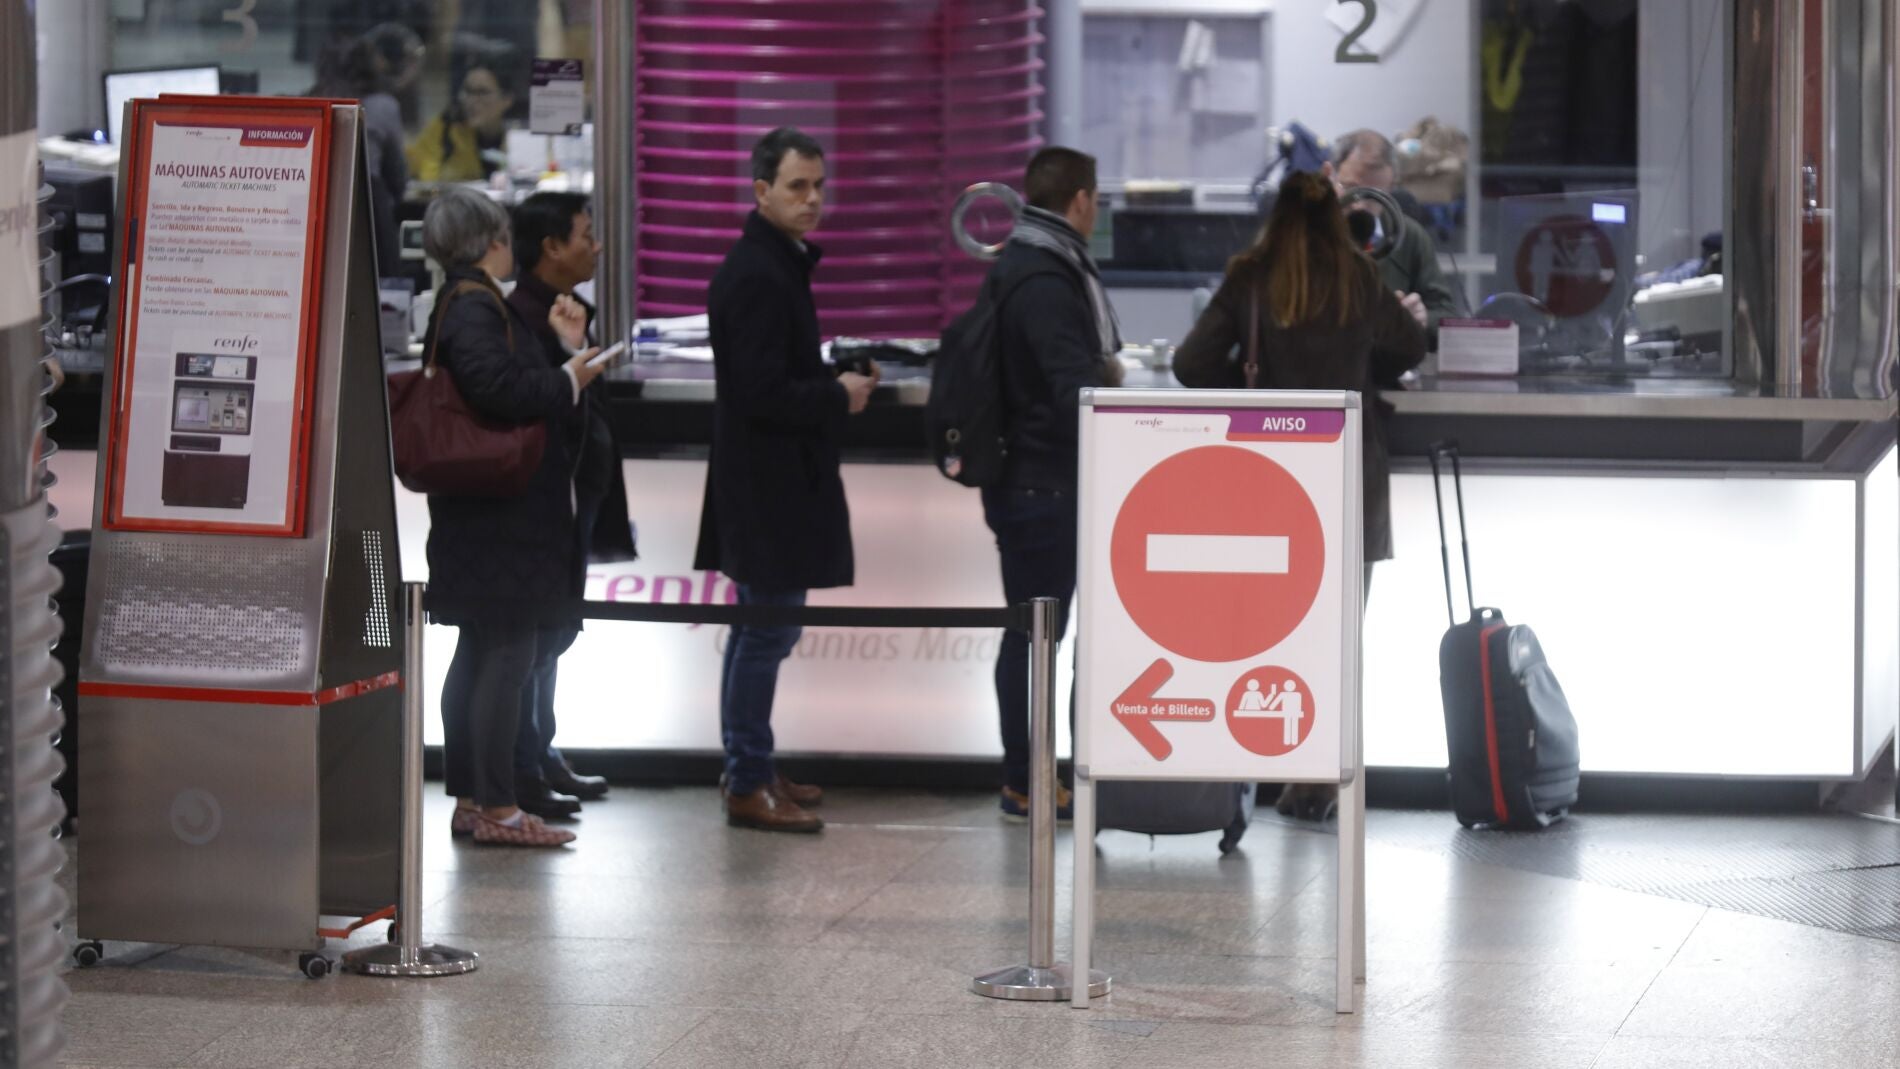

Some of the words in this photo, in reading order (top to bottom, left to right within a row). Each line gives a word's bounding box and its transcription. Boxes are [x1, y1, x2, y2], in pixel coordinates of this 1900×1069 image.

[1335, 0, 1379, 62] 2
[248, 130, 303, 141] INFORMACIÓN
[155, 161, 226, 178] MÁQUINAS
[229, 165, 306, 181] AUTOVENTA
[181, 181, 219, 190] AUTOMATIC
[219, 182, 241, 190] TICKET
[241, 183, 277, 192] MACHINES
[213, 334, 258, 353] renfe
[1134, 415, 1164, 427] renfe
[1262, 417, 1306, 431] AVISO
[1116, 703, 1148, 715] Venta
[1151, 703, 1166, 715] de
[1168, 703, 1211, 716] Billetes
